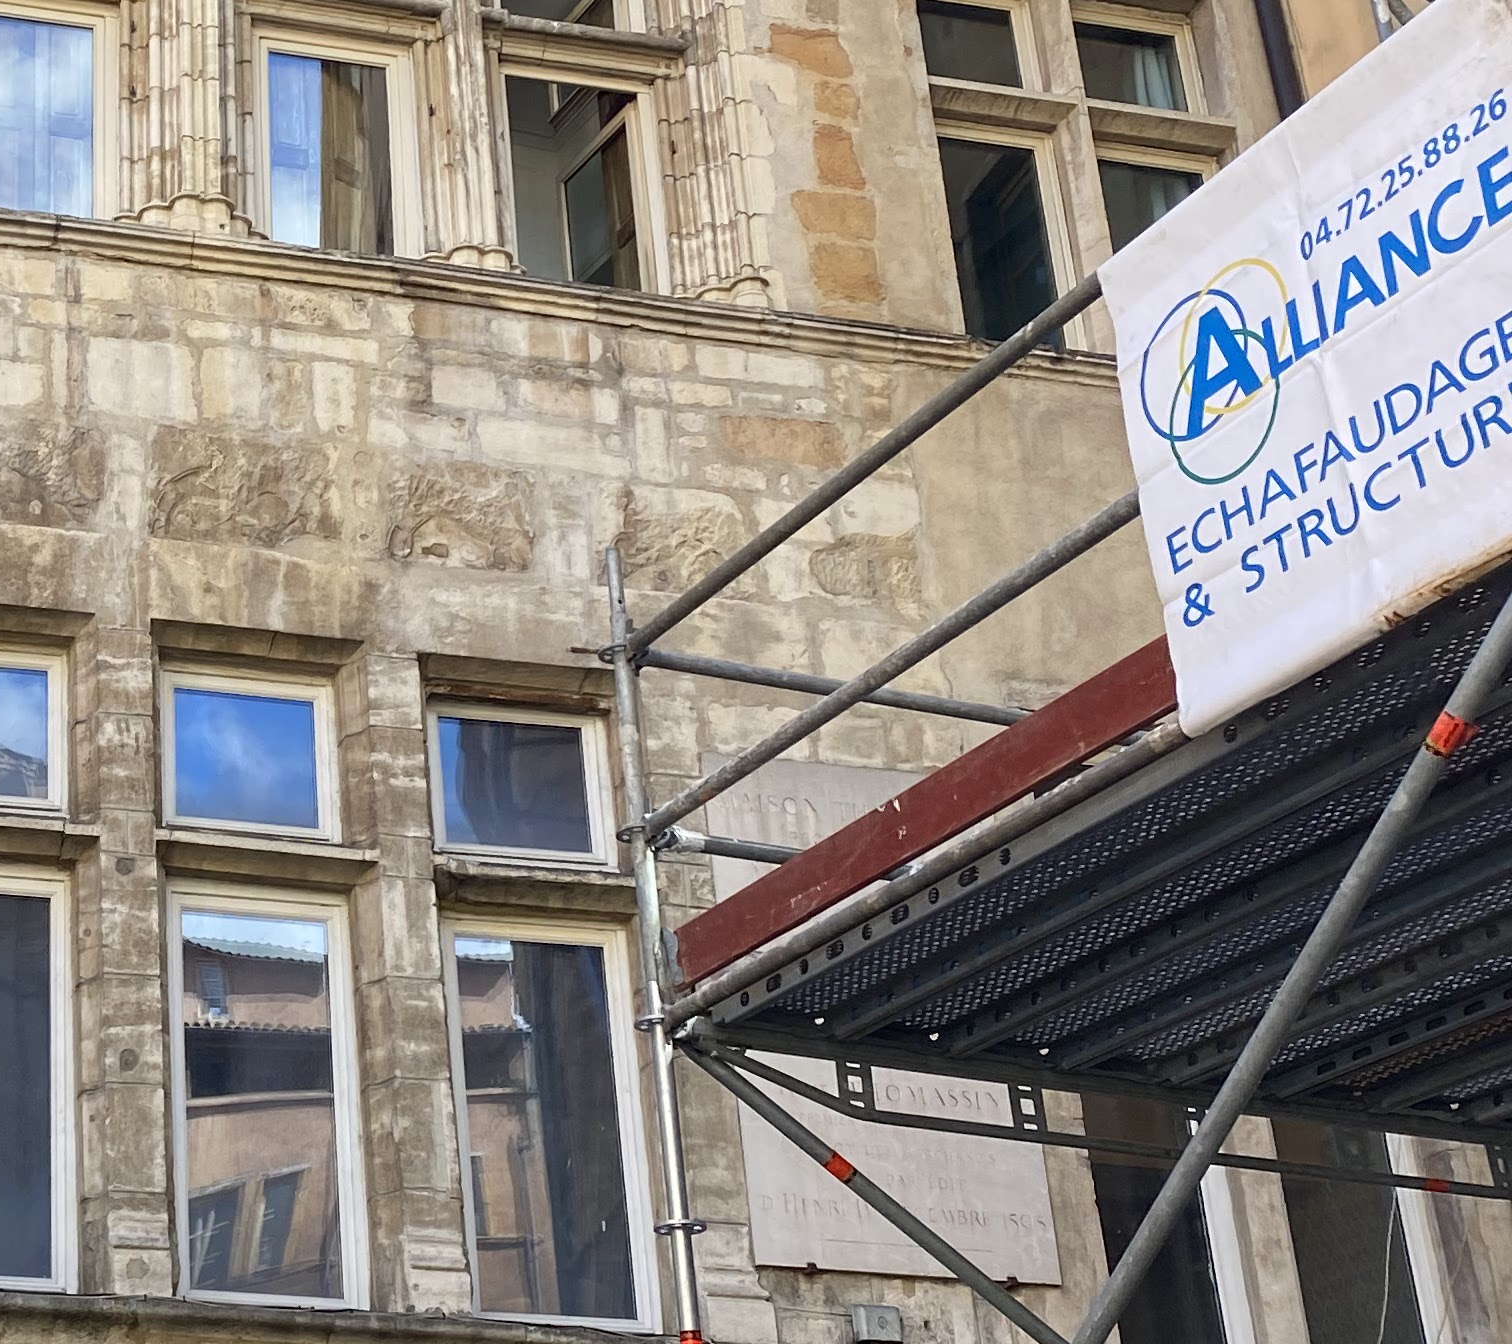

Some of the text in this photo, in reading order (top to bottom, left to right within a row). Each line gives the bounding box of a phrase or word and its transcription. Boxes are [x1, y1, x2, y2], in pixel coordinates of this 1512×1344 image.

[1187, 145, 1512, 440] ALLIANCE
[1300, 88, 1507, 261] 04.72.25.88.26
[1183, 383, 1512, 627] & STRUCTUR
